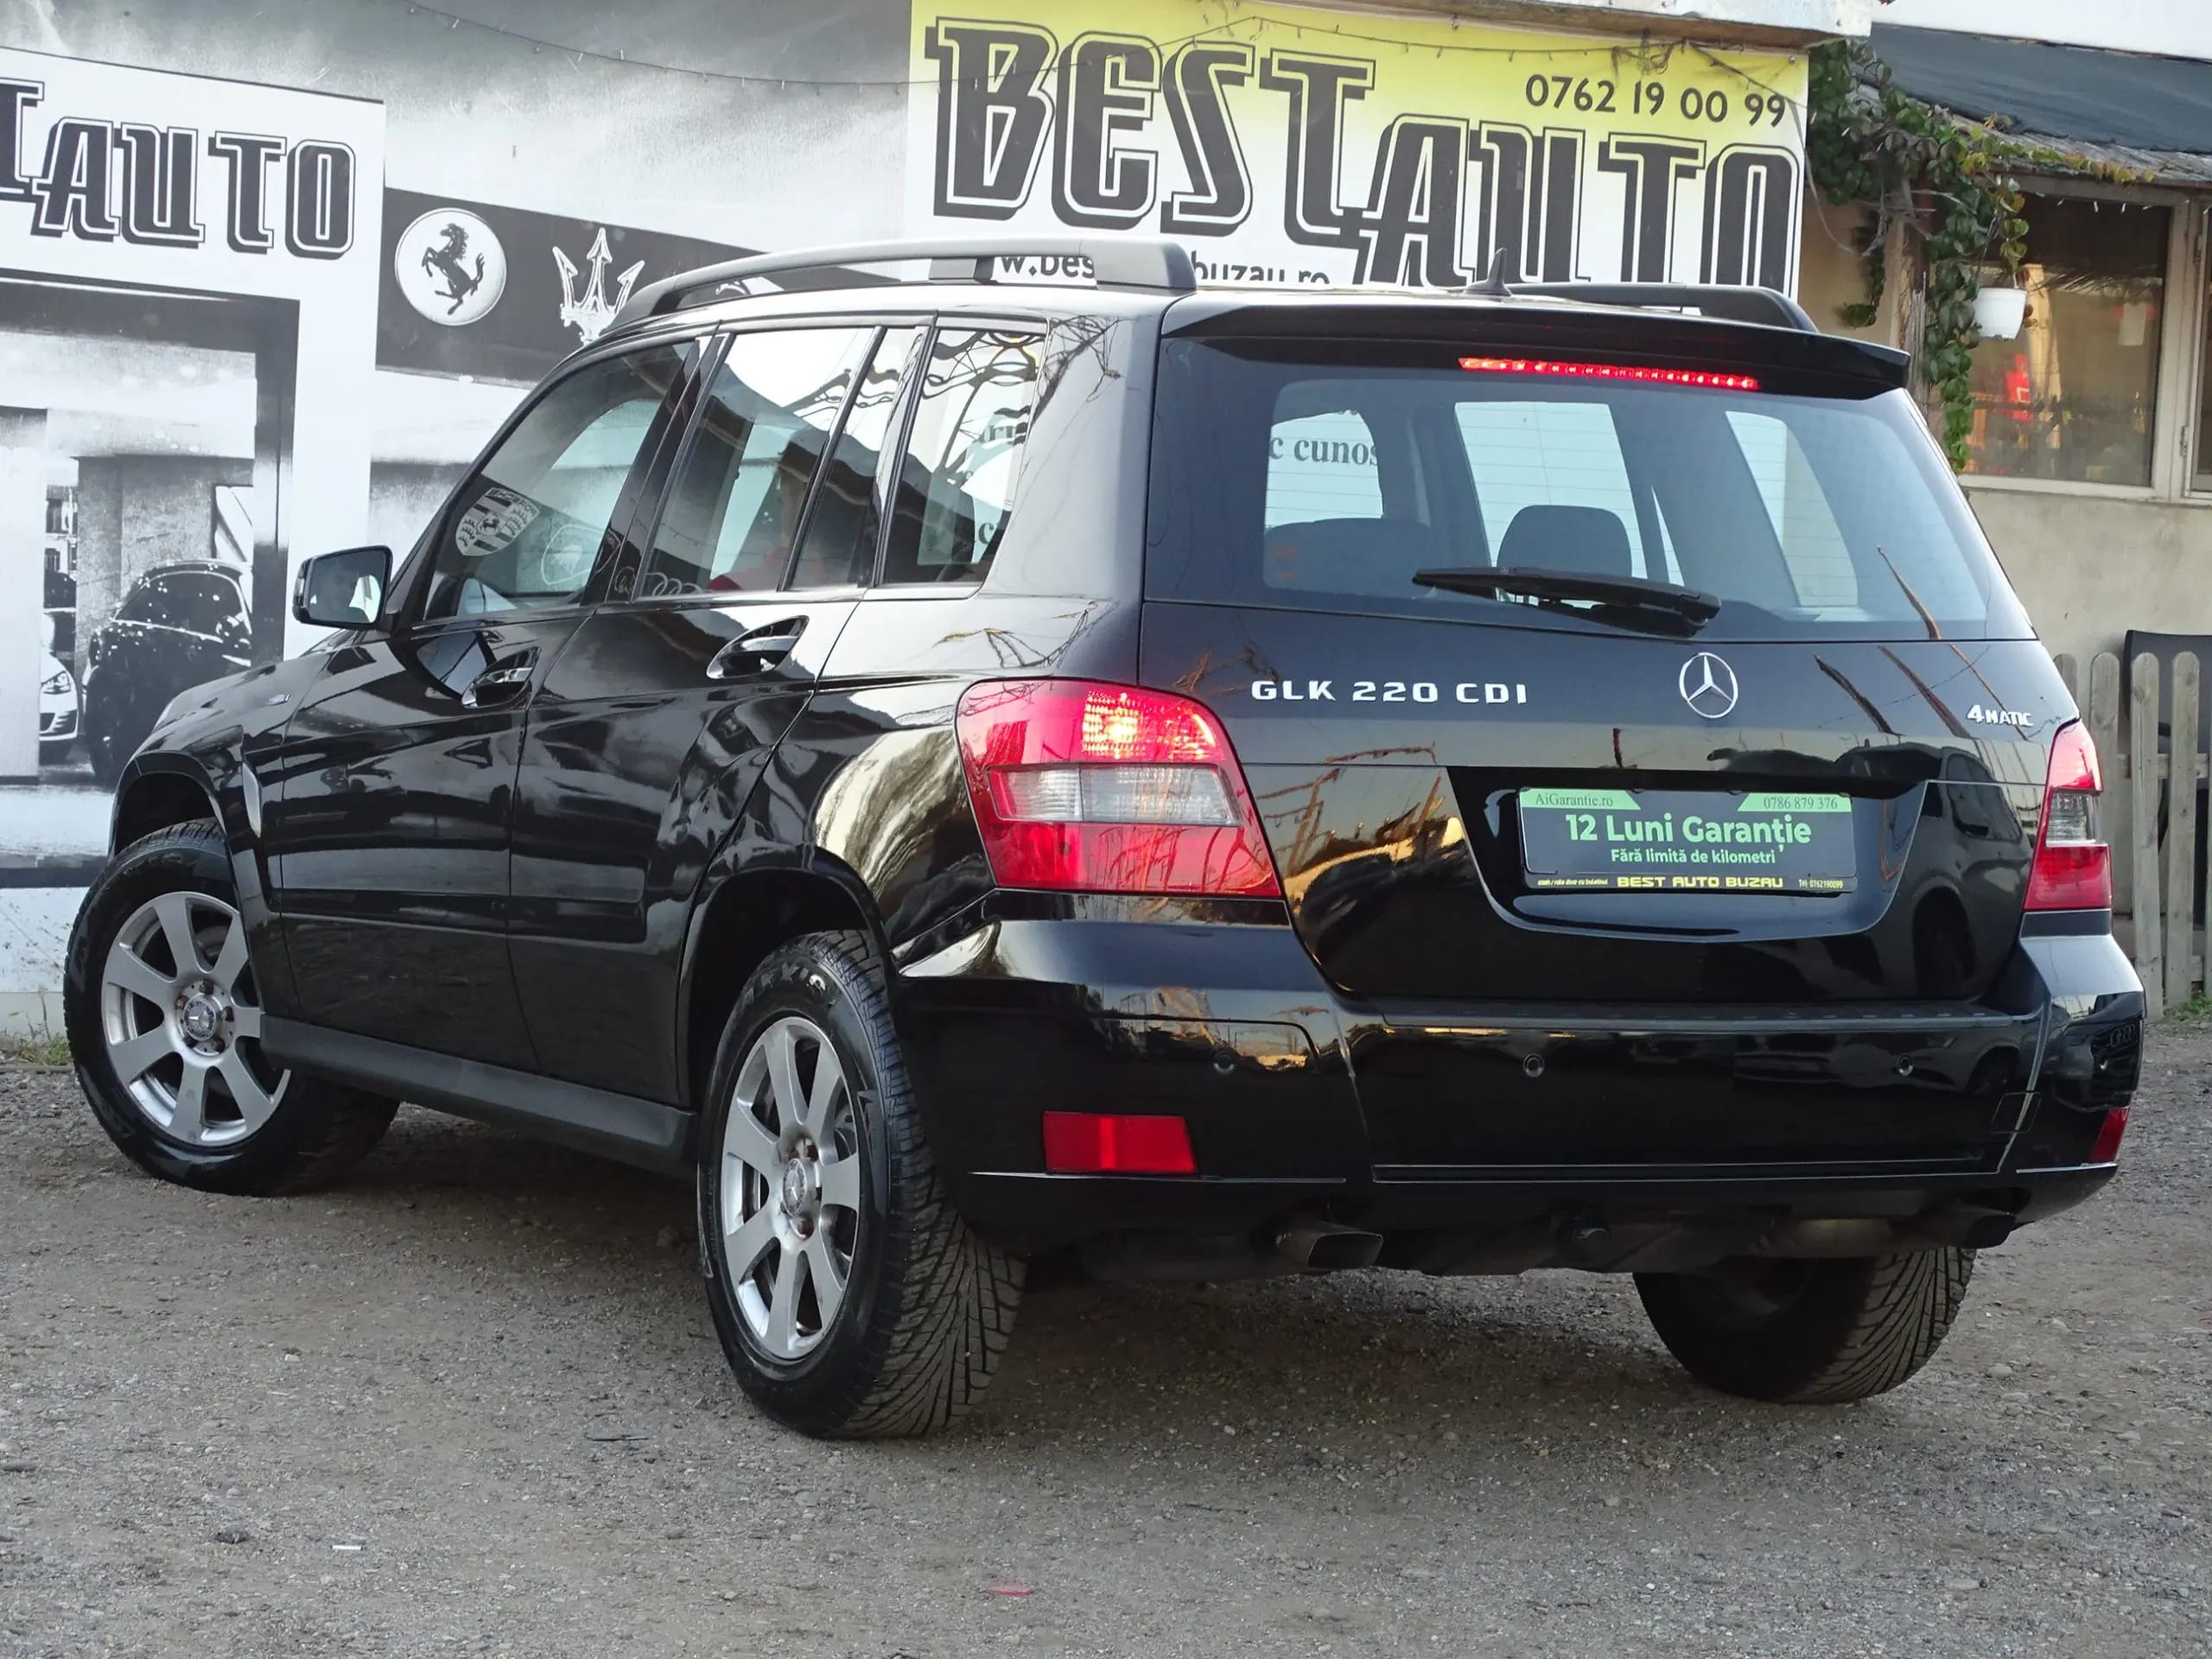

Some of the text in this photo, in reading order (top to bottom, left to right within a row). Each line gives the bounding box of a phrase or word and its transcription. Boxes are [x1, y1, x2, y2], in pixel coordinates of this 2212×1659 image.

[1525, 73, 1786, 128] 0762 19 00 99
[1251, 680, 1528, 704] GLK 220 CDI
[1763, 796, 1839, 810] 0786 879 376
[1565, 812, 1812, 853] 12 Luni Garanție
[1611, 848, 1776, 864] Fără limită de kilometri
[1617, 876, 1784, 888] BEST AUTO BUZAU
